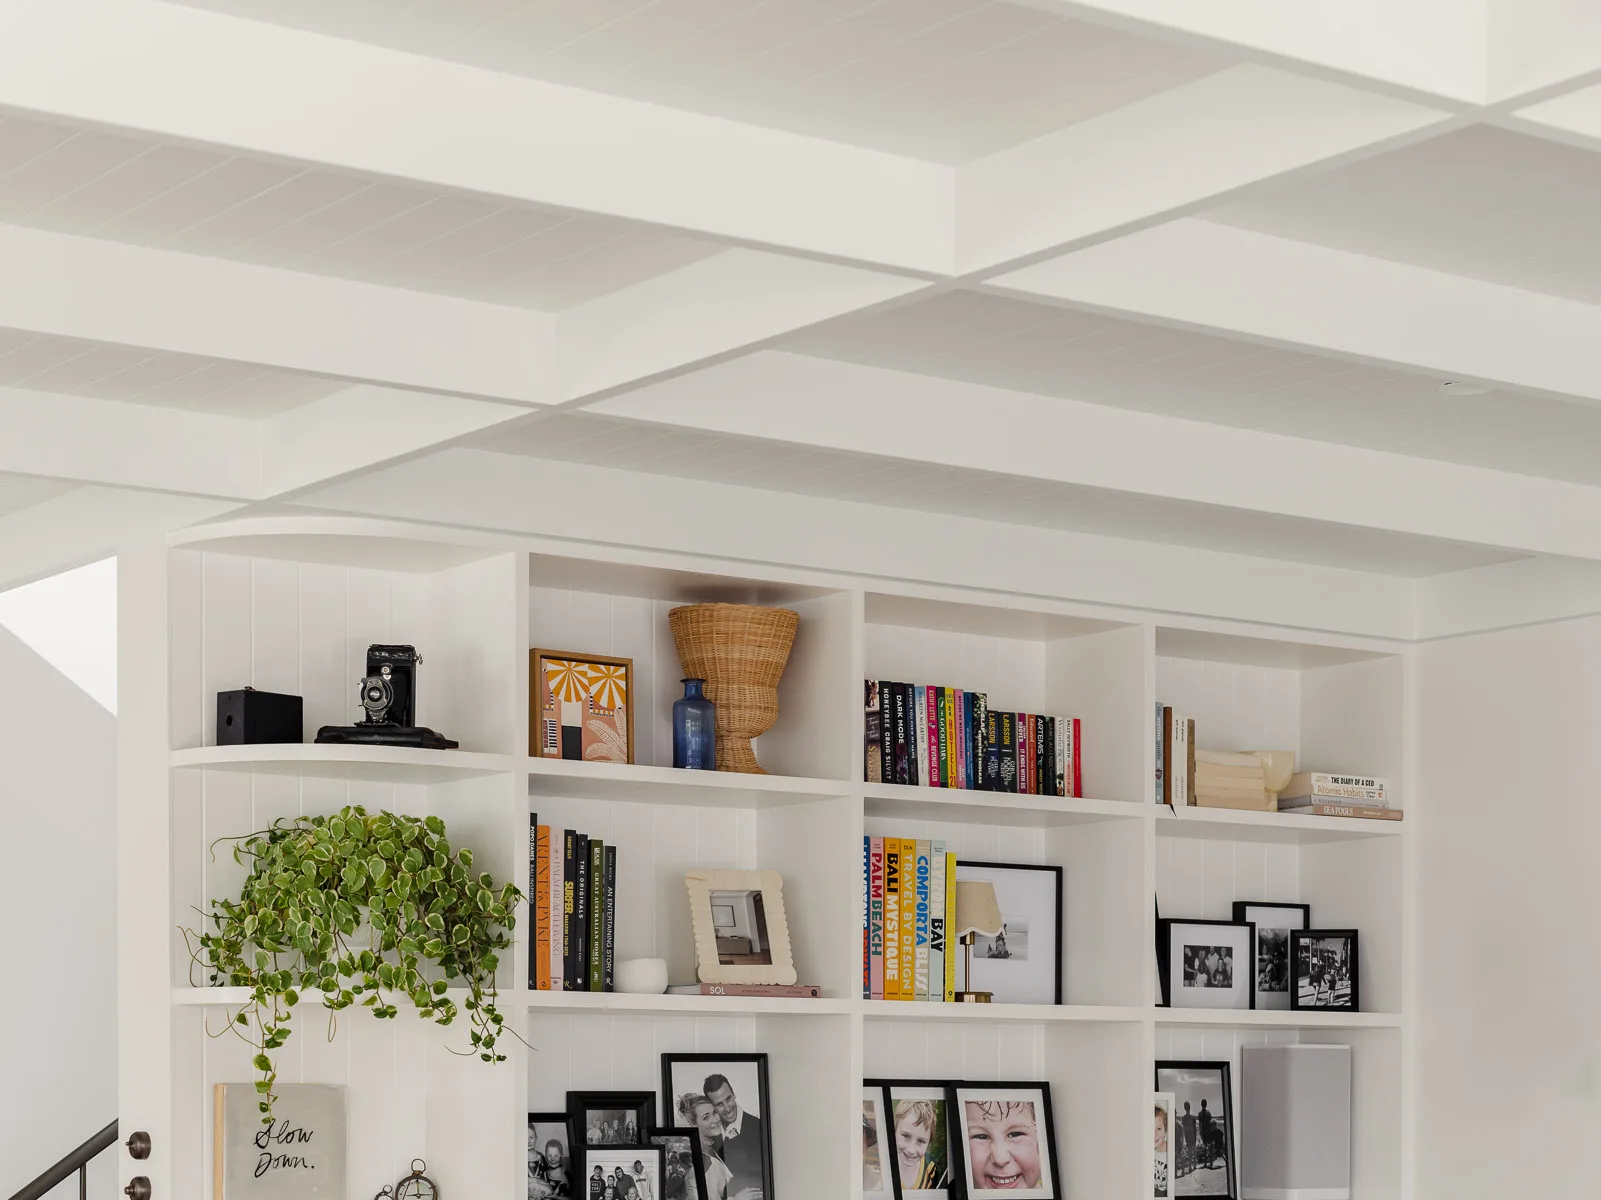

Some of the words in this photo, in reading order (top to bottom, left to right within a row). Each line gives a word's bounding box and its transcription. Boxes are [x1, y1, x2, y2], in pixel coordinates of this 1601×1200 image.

[883, 688, 891, 728] HONEYBEE
[896, 694, 904, 718] DARK
[897, 720, 905, 744] MODE
[988, 713, 996, 744] LARSSON
[930, 745, 938, 767] REVENGE
[1317, 786, 1342, 796] Atomic
[1343, 787, 1365, 798] Habits
[1331, 776, 1340, 785] THE
[1340, 777, 1354, 786] DIARY
[1354, 778, 1361, 786] OF
[1361, 779, 1366, 787] A
[1323, 806, 1335, 814] SEA
[1335, 806, 1354, 816] POOLS
[537, 832, 549, 887] ARENT
[871, 852, 883, 898] PALM
[886, 853, 899, 893] BALI
[564, 880, 574, 914] SURFER
[607, 886, 614, 898] AN
[903, 854, 913, 907] TRAVEL
[915, 855, 929, 946] COMPORTA
[537, 905, 549, 948] PYKE
[605, 898, 613, 948] ENTERTAINING
[871, 900, 883, 956] BEACH
[886, 895, 899, 981] MYSTIQUE
[903, 912, 912, 930] BY
[930, 918, 943, 953] BAY
[605, 949, 613, 973] STORY
[902, 935, 912, 989] DESIGN
[915, 948, 928, 991] BLISS
[709, 986, 726, 995] SOL
[253, 1118, 314, 1149] Slow
[254, 1152, 315, 1178] Down.
